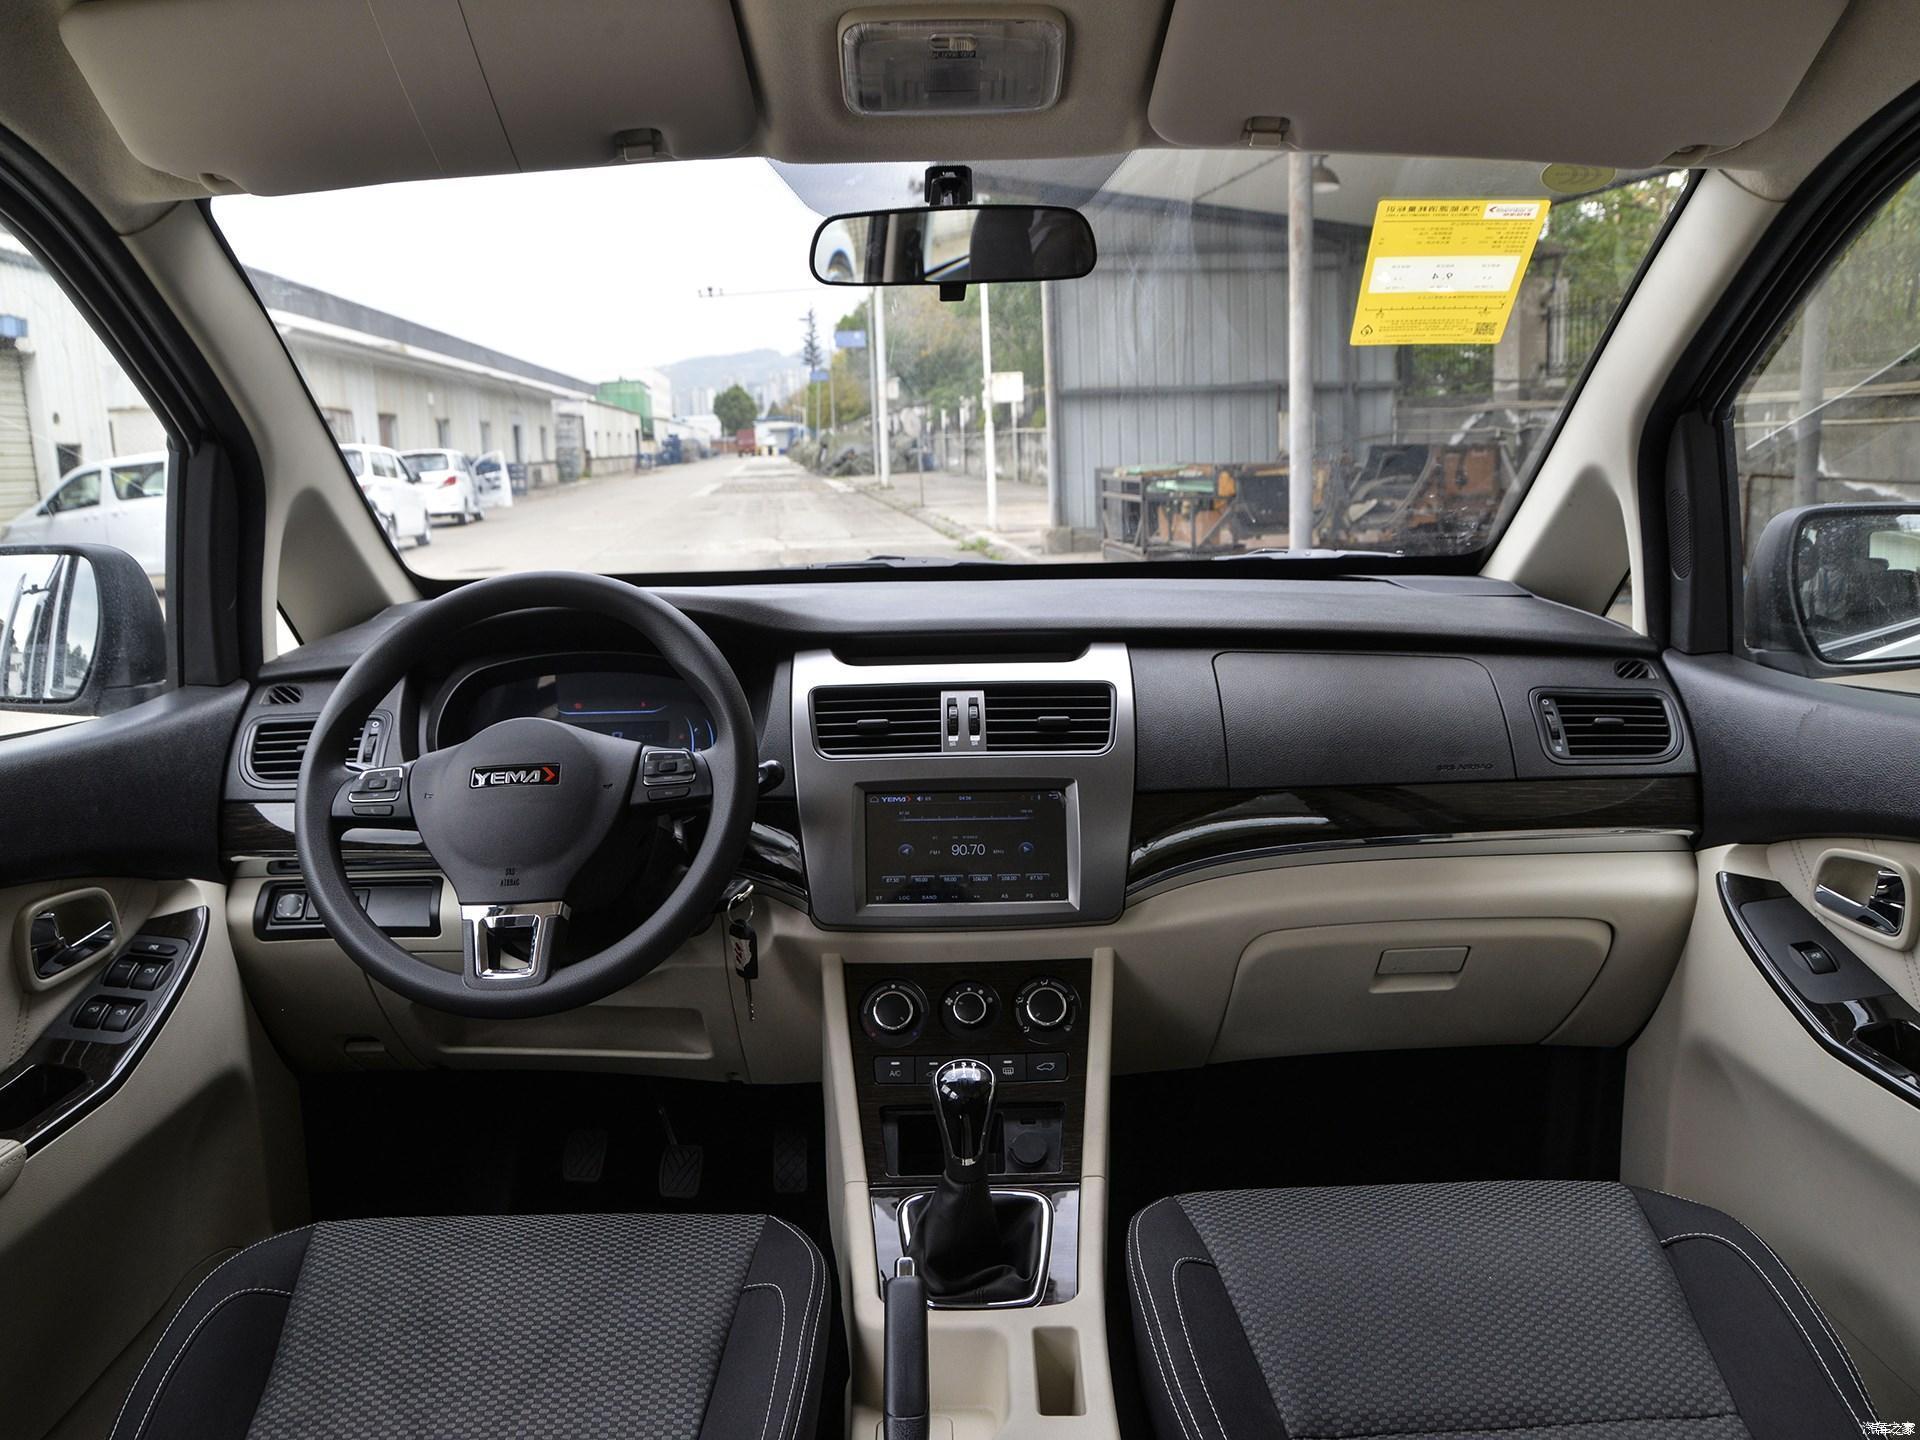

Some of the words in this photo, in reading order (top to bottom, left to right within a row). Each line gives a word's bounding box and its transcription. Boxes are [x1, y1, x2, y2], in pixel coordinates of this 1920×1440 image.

[473, 770, 541, 787] YEMA
[951, 843, 986, 857] 90.70
[889, 1069, 902, 1077] A/C
